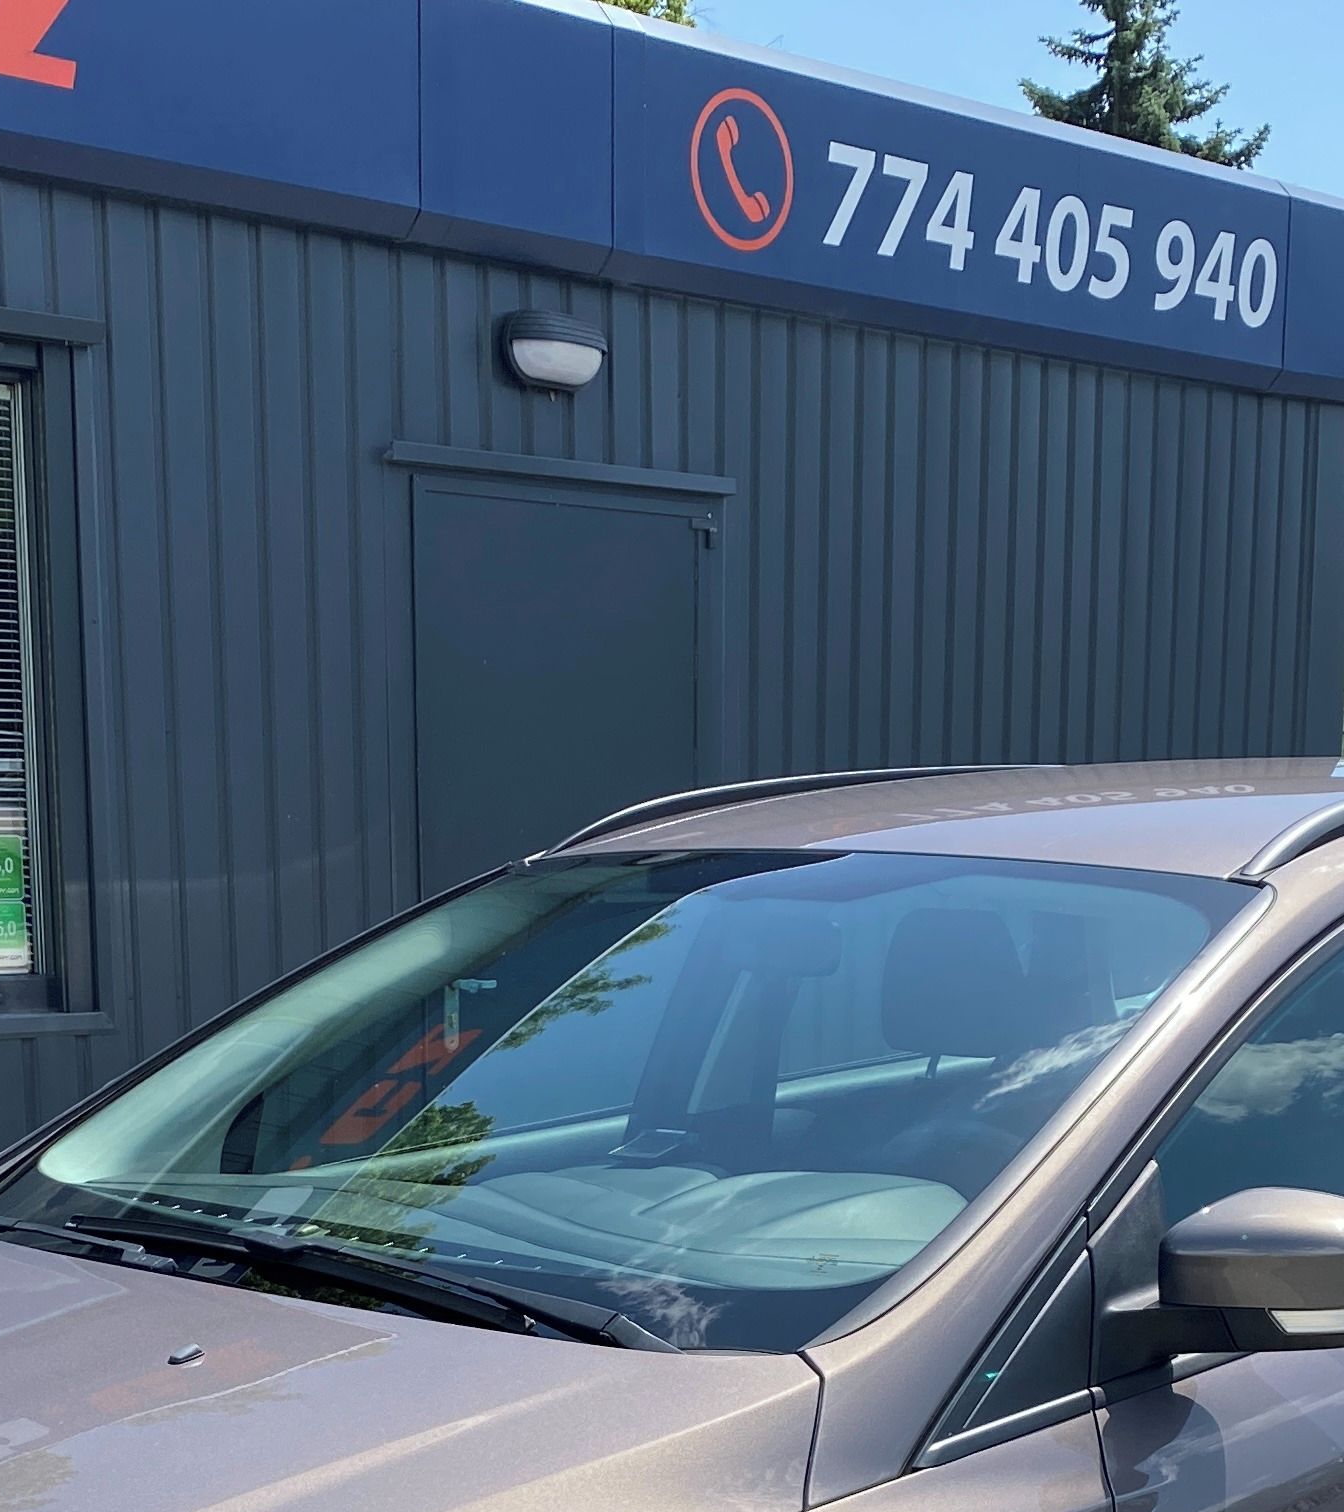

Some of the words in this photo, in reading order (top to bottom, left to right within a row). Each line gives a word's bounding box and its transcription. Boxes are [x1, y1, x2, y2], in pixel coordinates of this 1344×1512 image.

[822, 140, 975, 271] 774
[994, 186, 1135, 300] 405
[1153, 218, 1278, 328] 940
